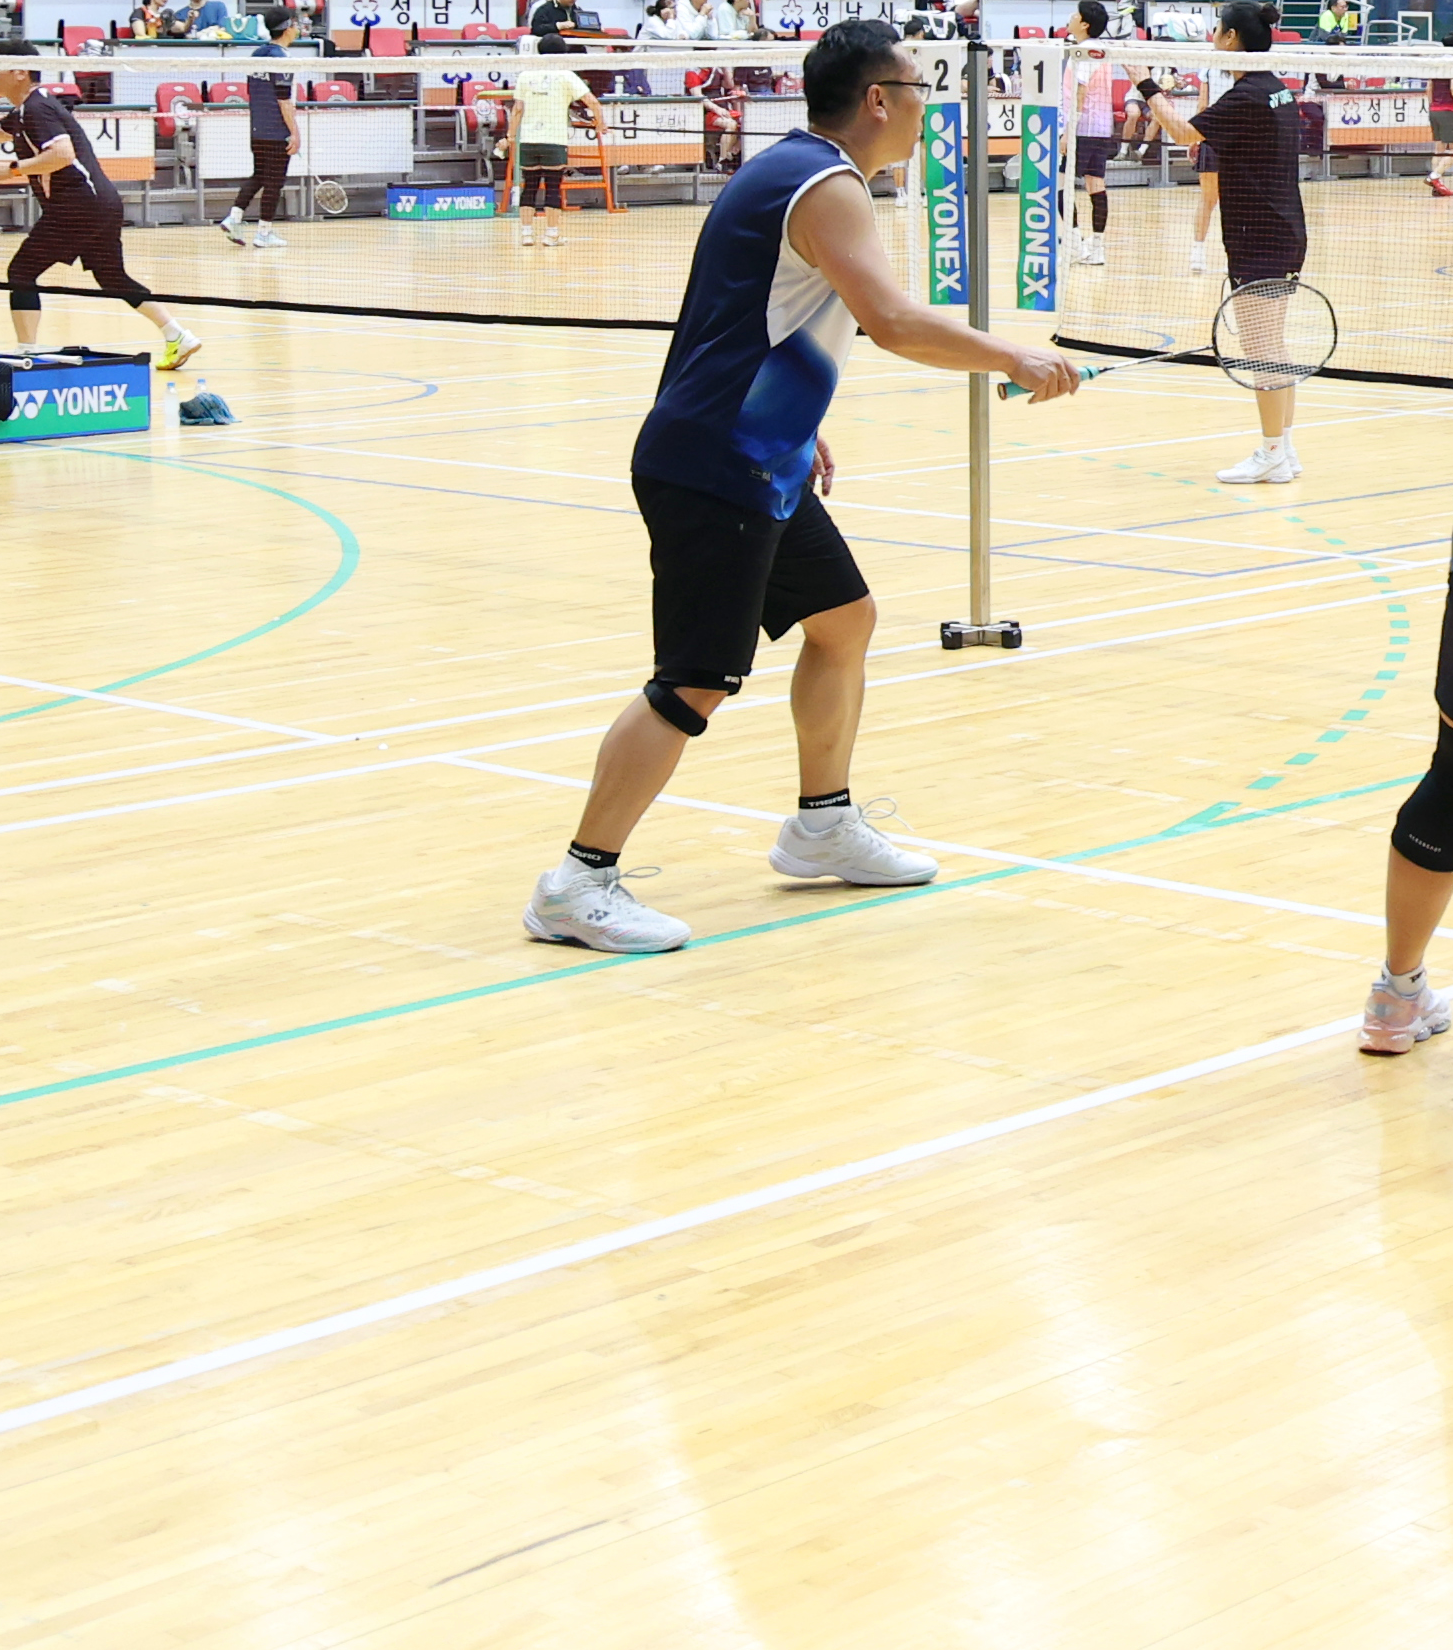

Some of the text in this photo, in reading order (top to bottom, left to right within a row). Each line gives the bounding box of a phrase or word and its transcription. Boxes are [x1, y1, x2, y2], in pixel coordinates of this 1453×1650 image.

[932, 59, 950, 92] 2
[1032, 61, 1044, 93] 1
[453, 195, 486, 211] YONEX
[929, 181, 964, 293] YONEX
[1022, 188, 1051, 299] YONEX
[53, 382, 129, 416] YONEX
